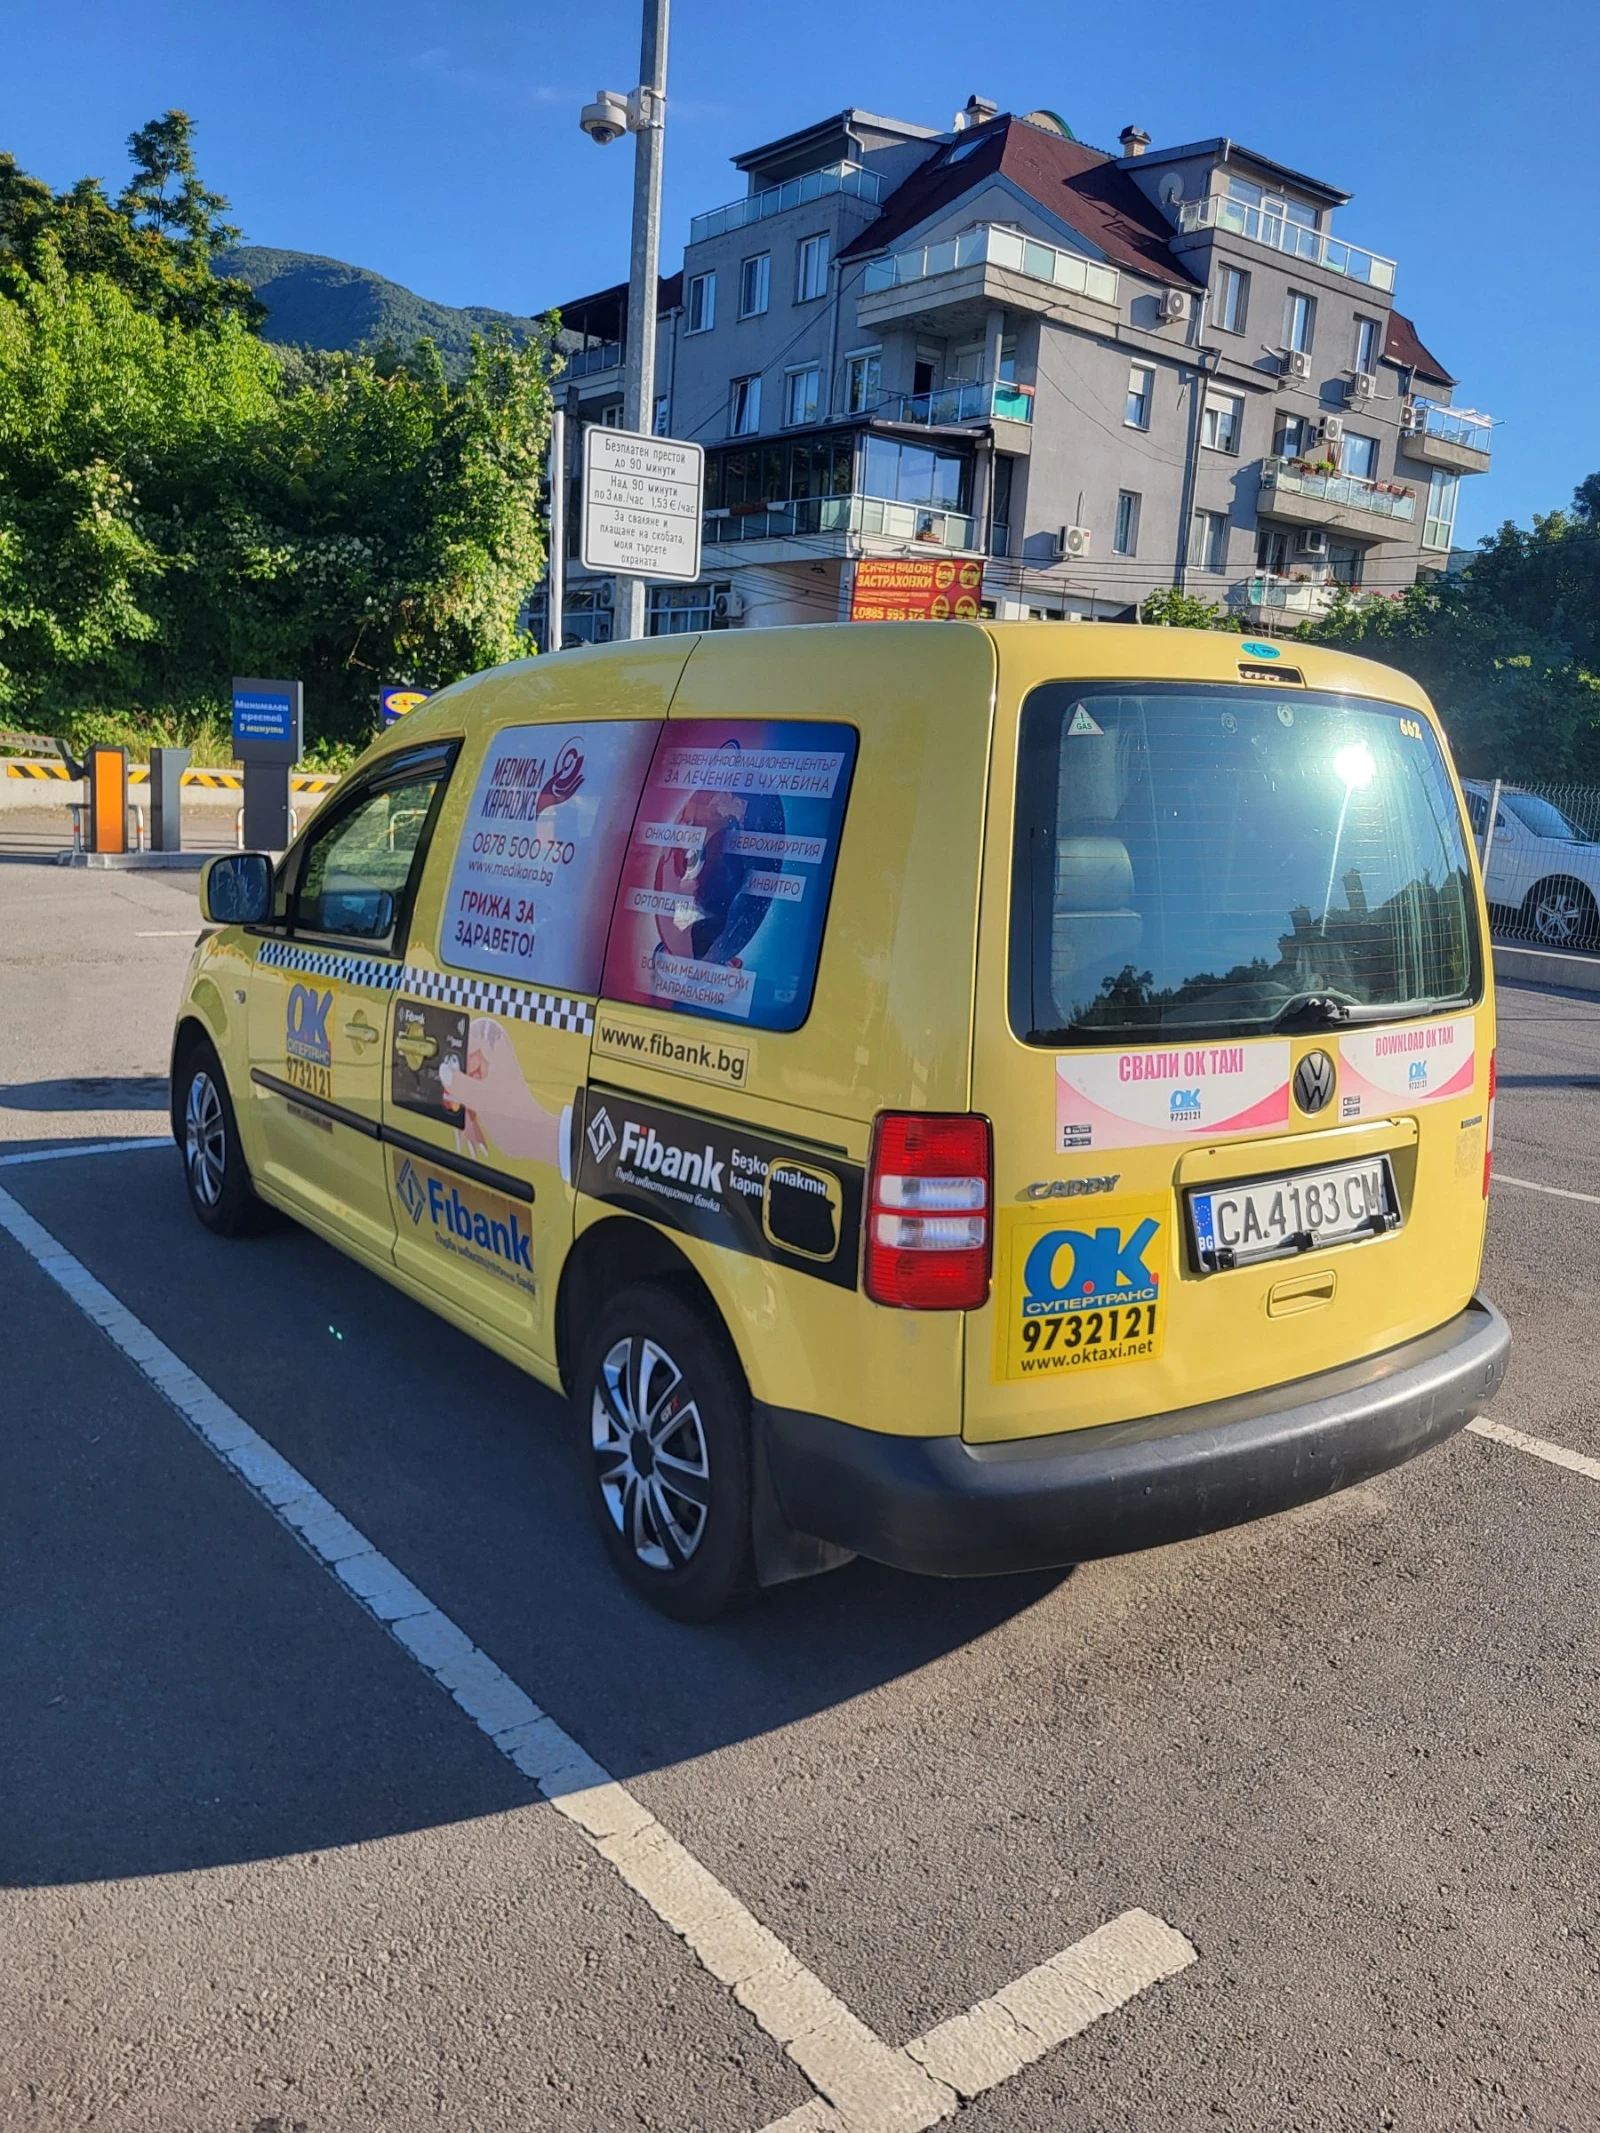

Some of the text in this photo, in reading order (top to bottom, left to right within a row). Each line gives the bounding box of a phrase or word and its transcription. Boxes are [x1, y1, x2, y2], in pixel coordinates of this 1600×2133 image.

[605, 438, 686, 464] Безплатен престой
[615, 458, 676, 477] до 90 минути
[594, 490, 604, 499] по
[606, 489, 612, 500] 3
[611, 475, 678, 498] Над 90 минути
[614, 510, 668, 528] За сваляне и
[600, 524, 635, 537] плащане
[640, 530, 648, 539] на
[614, 540, 667, 555] моля търсете
[896, 562, 934, 574] ВИДОВЕ
[857, 574, 933, 589] ЗАСТРАХОВКИ
[234, 699, 289, 712] Минимален
[240, 713, 283, 723] престой
[246, 725, 285, 735] минути
[1076, 722, 1093, 731] GAS
[1400, 717, 1423, 741] 662
[797, 758, 838, 772] ЦЕНТЪР
[664, 769, 830, 793] ЗА ЛЕЧЕНИЕ В ЧУЖБИНА
[645, 826, 702, 843] ОНКОЛОГИЯ
[731, 835, 821, 857] НЕВРОХИРУРГИЯ
[472, 832, 576, 865] 0878 500 730
[468, 860, 554, 887] www.medikara.bg
[750, 877, 801, 895] ИНВИТРО
[460, 890, 535, 924] ГРИЖА ЗА
[455, 920, 536, 958] ЗДРАВЕТО!
[680, 963, 749, 992] МЕДИЦИНСКИ
[655, 979, 725, 1006] НАПРАВЛЕНИЯ
[1375, 1025, 1454, 1057] DOWNLOAD OK TAXI
[601, 1026, 745, 1081] www.fibank.bg
[1118, 1048, 1244, 1082] СВАЛИ OK TAXI
[286, 1055, 332, 1099] 9732121
[1170, 1111, 1201, 1122] 9732121
[619, 1120, 725, 1194] Fibank
[1027, 1174, 1121, 1199] CADDY
[427, 1177, 534, 1274] Fibank
[1198, 1235, 1213, 1251] BG
[1026, 1287, 1155, 1315] СУПЕРТРАНС
[1022, 1304, 1157, 1353] 9732121
[1021, 1340, 1154, 1372] www.oktaxi.net
